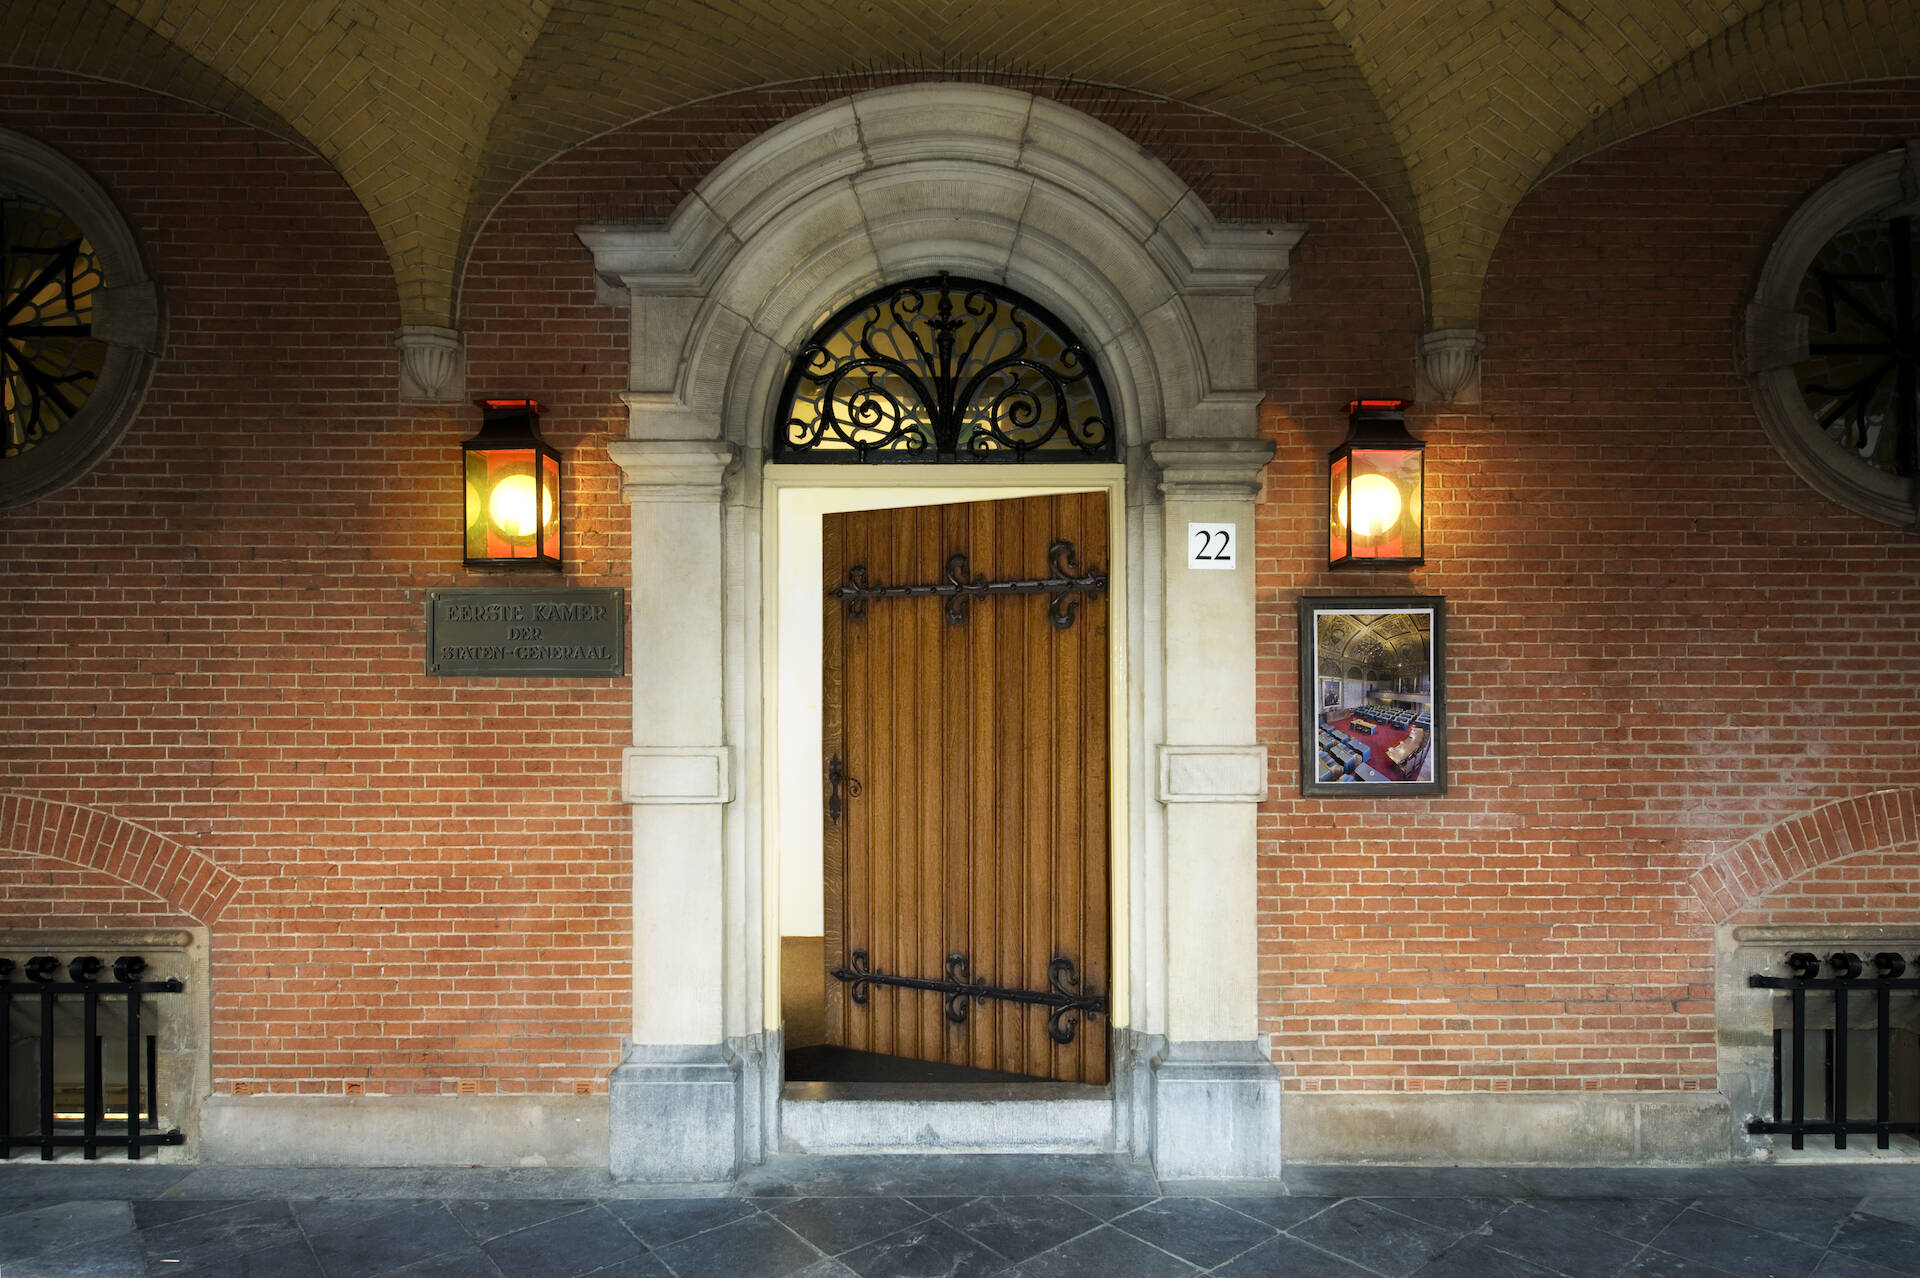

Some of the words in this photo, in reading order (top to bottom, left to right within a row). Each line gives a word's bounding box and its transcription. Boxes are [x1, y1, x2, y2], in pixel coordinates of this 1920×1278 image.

[1195, 530, 1231, 560] 22
[448, 604, 524, 622] EERSTE
[531, 603, 608, 622] KAMER
[507, 626, 543, 641] DER
[441, 646, 611, 661] STATEN-GENERAAL
